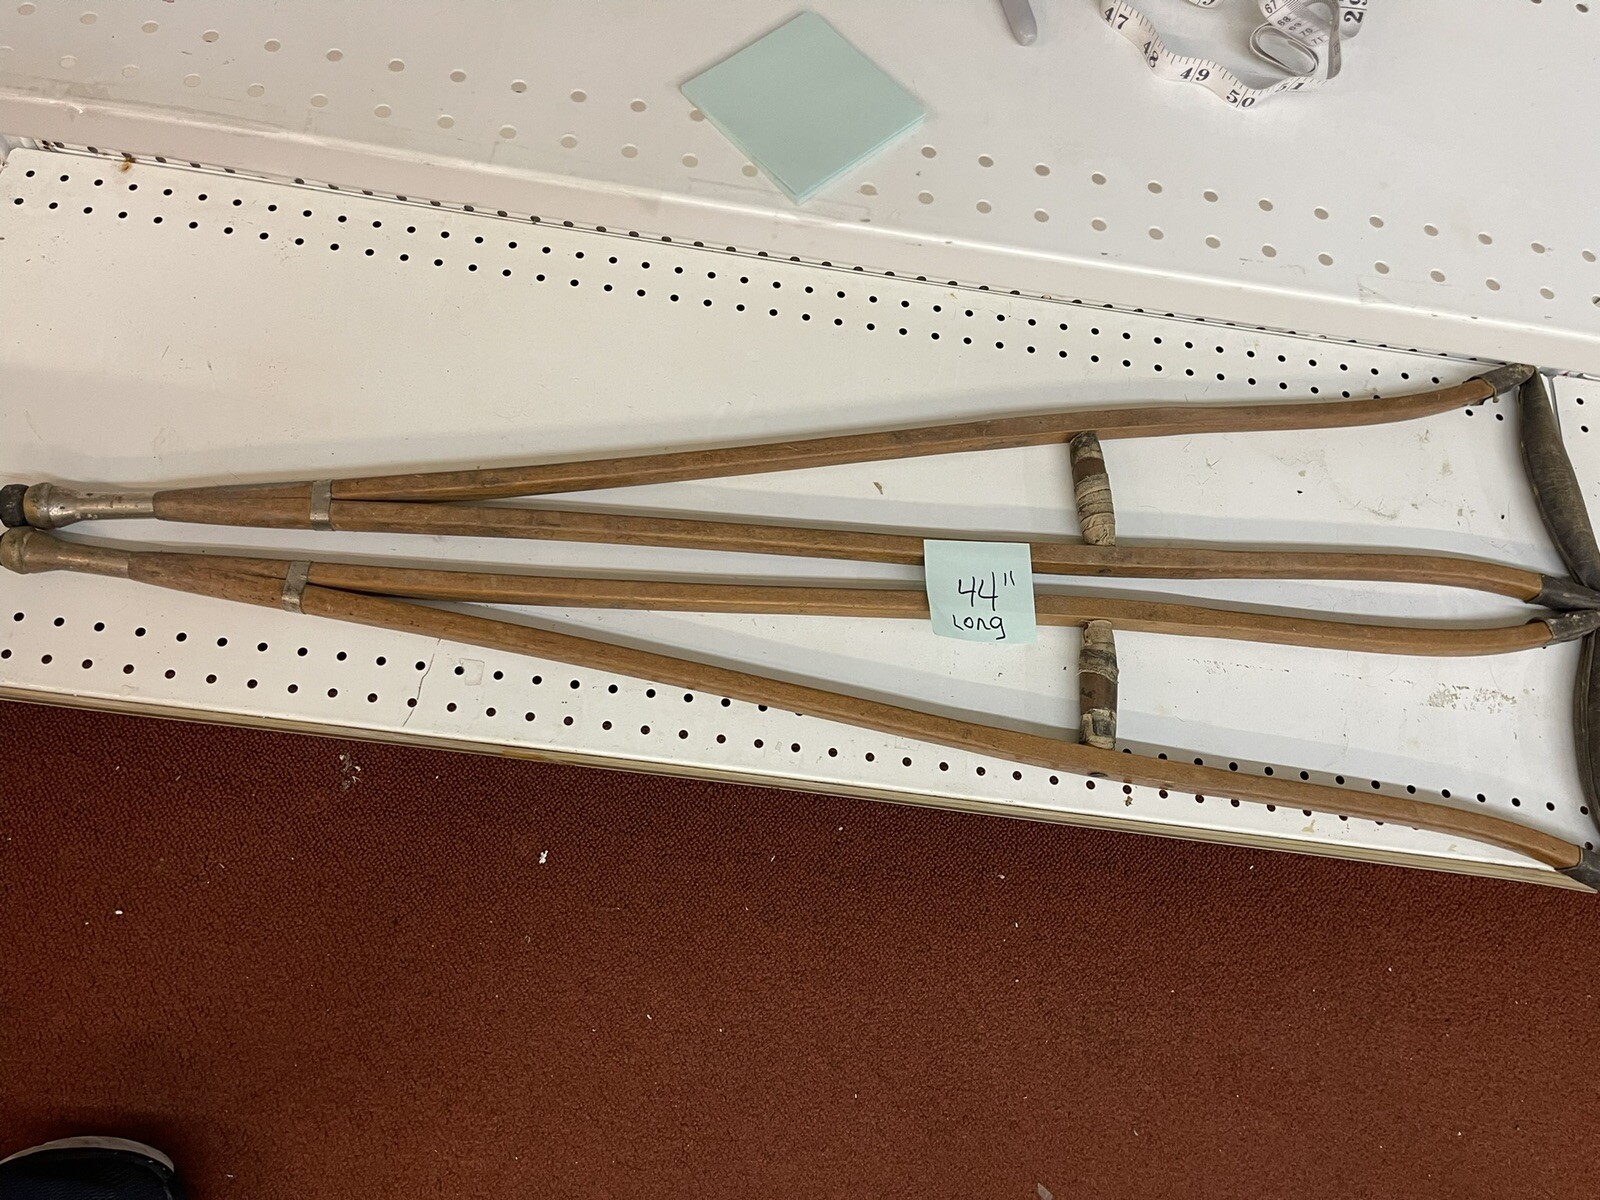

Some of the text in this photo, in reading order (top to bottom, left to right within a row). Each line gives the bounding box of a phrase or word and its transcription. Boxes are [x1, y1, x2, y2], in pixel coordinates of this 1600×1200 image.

[1104, 7, 1130, 31] 47
[1143, 41, 1160, 69] 48
[1180, 67, 1211, 83] 49
[1226, 88, 1257, 109] 50
[1274, 81, 1306, 94] 51
[957, 570, 1016, 612] 44"
